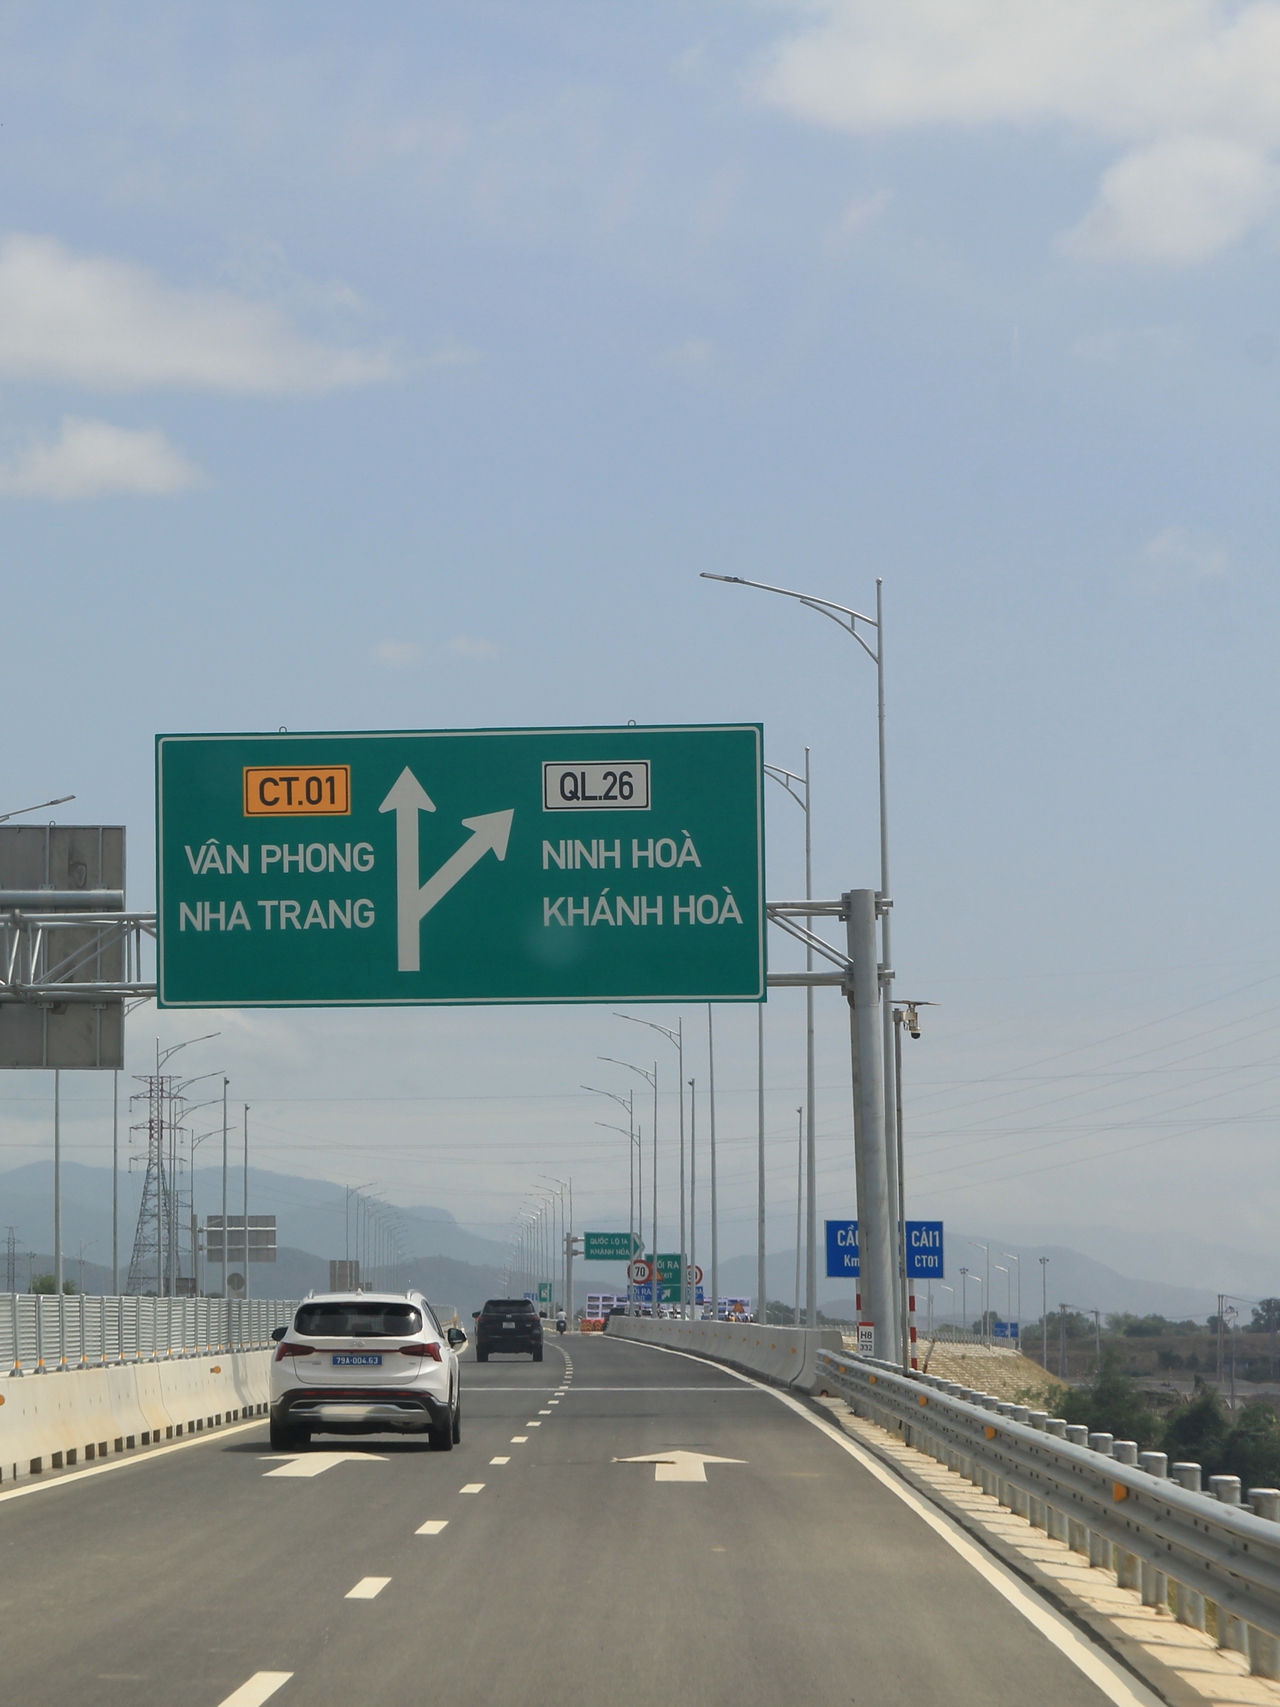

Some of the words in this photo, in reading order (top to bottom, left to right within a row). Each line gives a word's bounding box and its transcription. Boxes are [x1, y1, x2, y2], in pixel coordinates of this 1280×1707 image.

[257, 775, 337, 807] CT.01
[559, 770, 635, 803] QL.26
[184, 838, 250, 875] VÂN
[261, 841, 375, 874] PHONG
[542, 839, 620, 870] NINH
[632, 830, 702, 869] HOÀ
[543, 888, 664, 927] KHÁNH
[673, 886, 744, 925] HOÀ
[179, 901, 251, 932] NHA
[258, 898, 376, 931] TRANG
[590, 1236, 609, 1245] QUỐC
[610, 1237, 620, 1246] LỘ
[667, 1261, 680, 1269] RA
[914, 1255, 939, 1268] CT01
[635, 1266, 646, 1278] 70
[641, 1287, 652, 1295] RA
[860, 1331, 873, 1340] H8
[860, 1344, 873, 1352] 332
